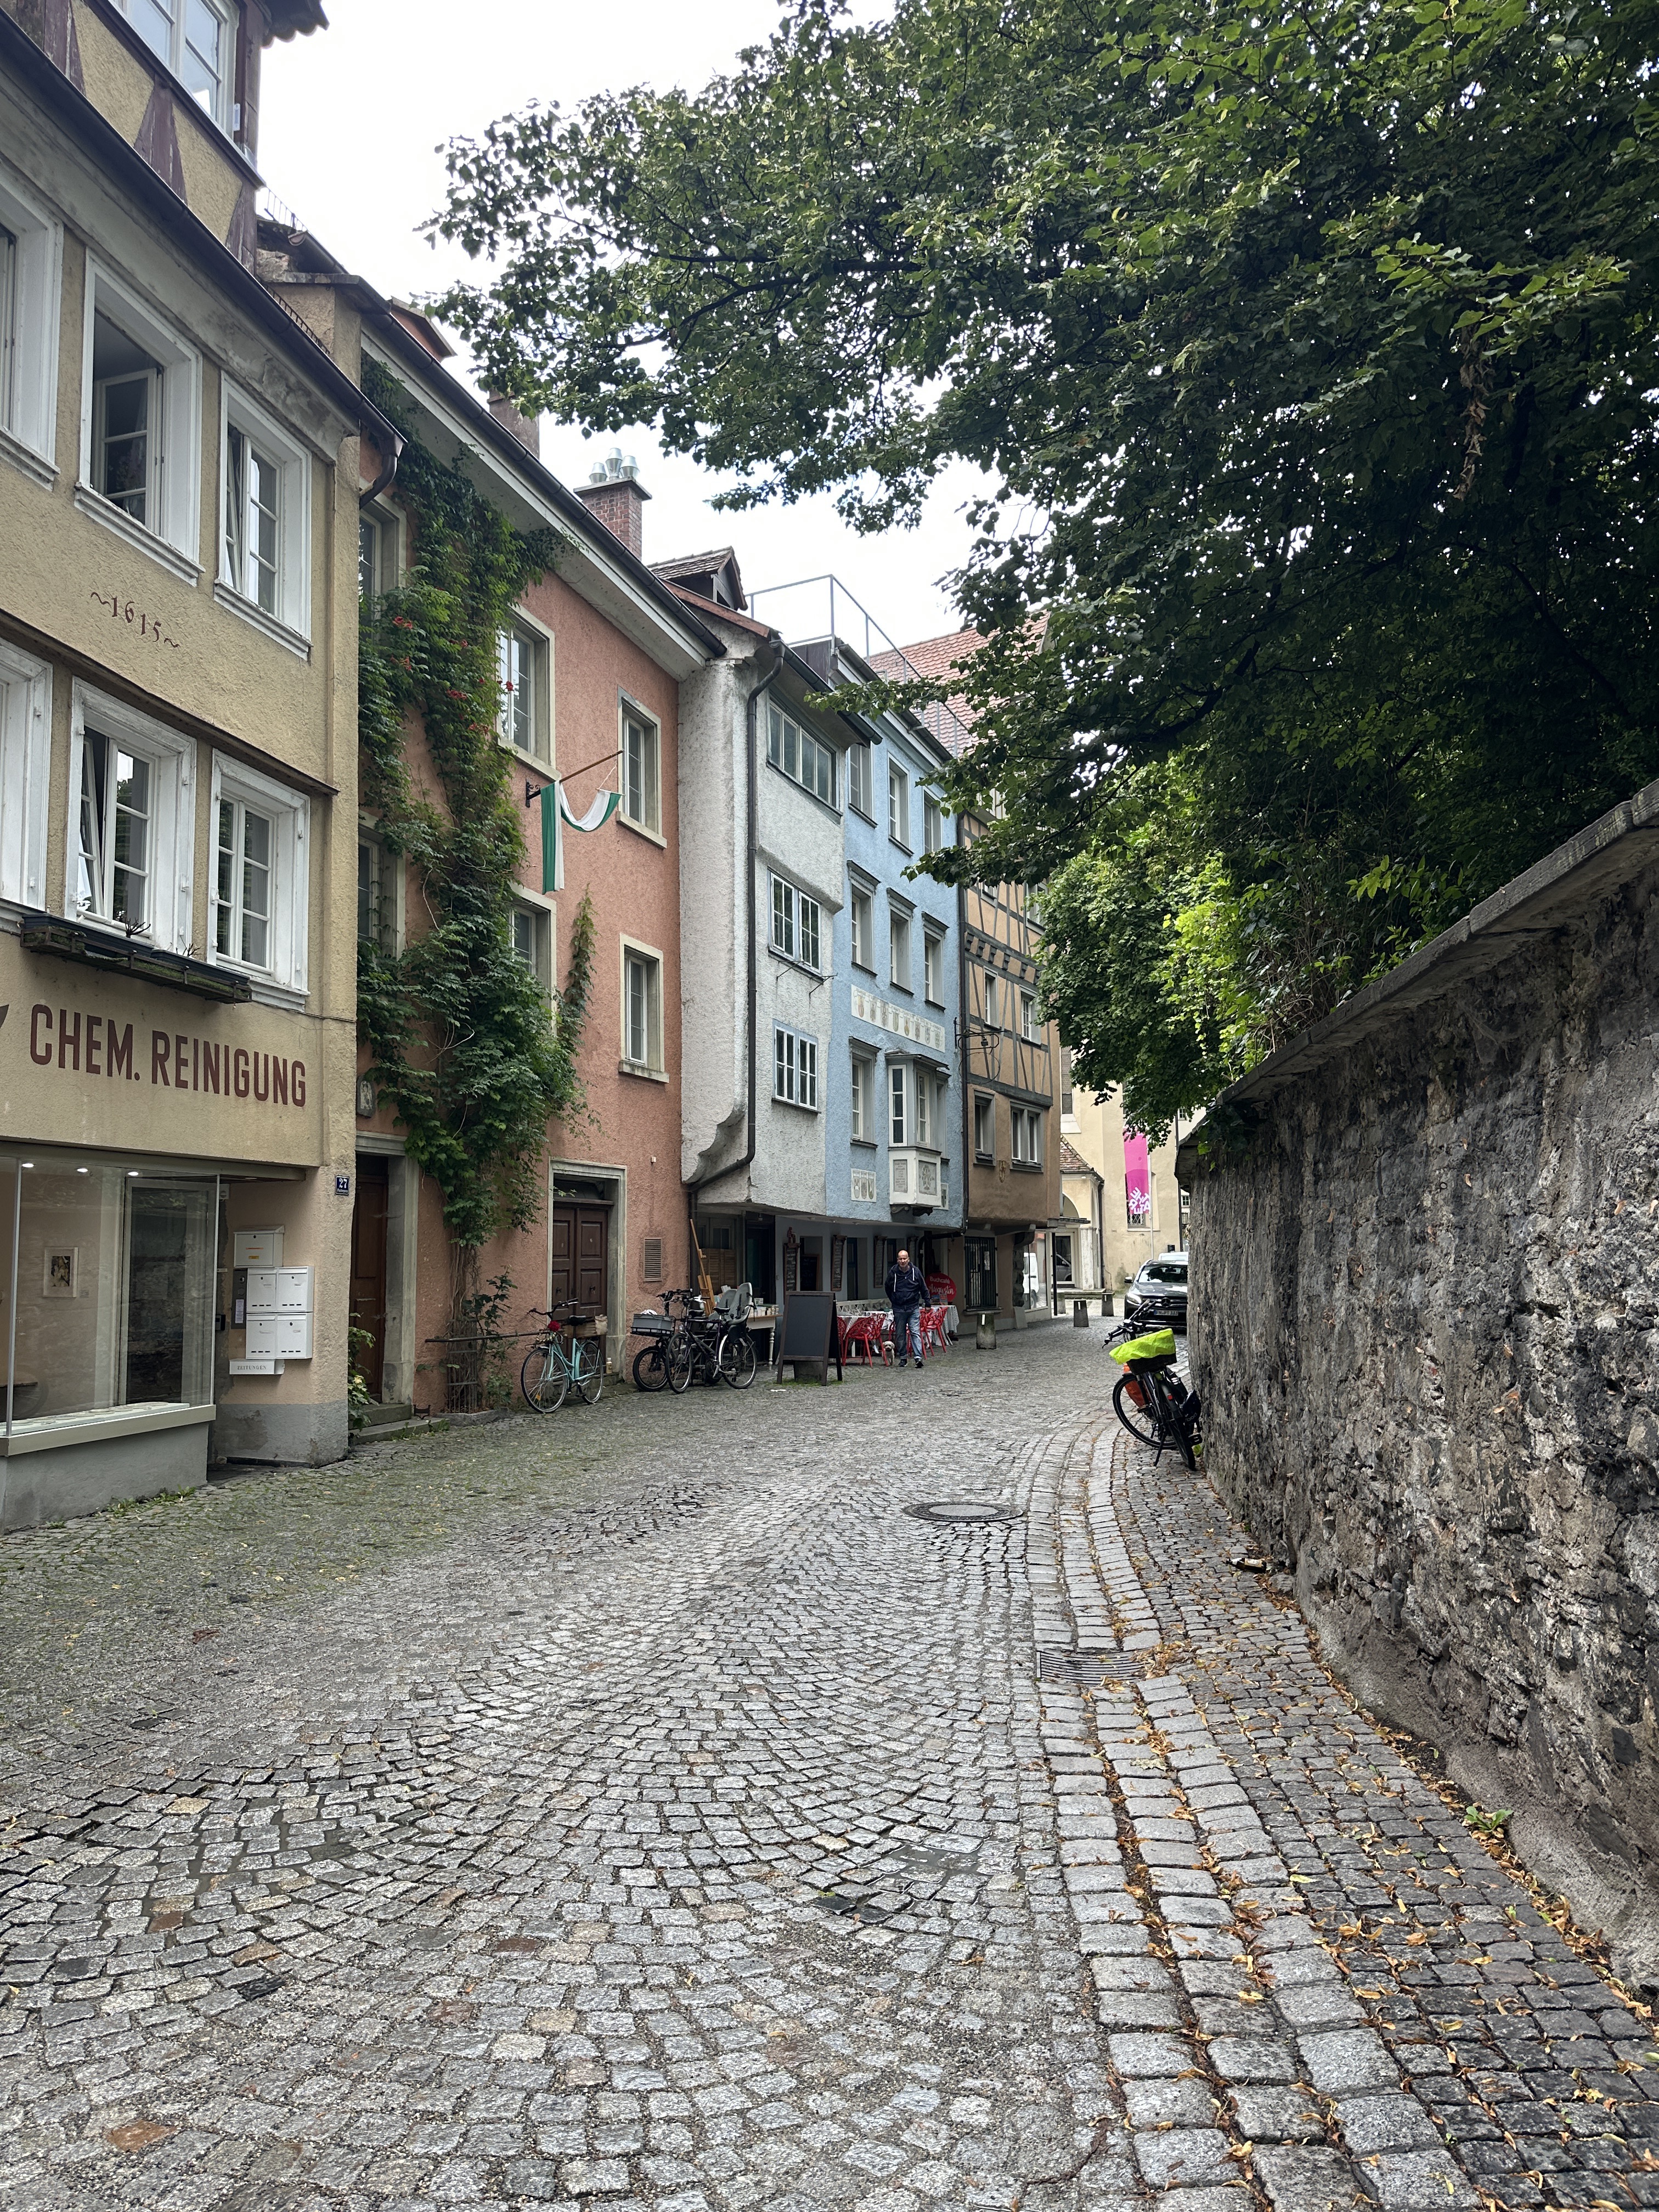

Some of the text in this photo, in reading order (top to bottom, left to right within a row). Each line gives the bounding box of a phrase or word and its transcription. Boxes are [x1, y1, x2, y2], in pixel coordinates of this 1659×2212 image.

[30, 1004, 306, 1107] CHEM. REINIGUNG
[338, 1177, 348, 1189] 27
[928, 1284, 955, 1295] Augustin
